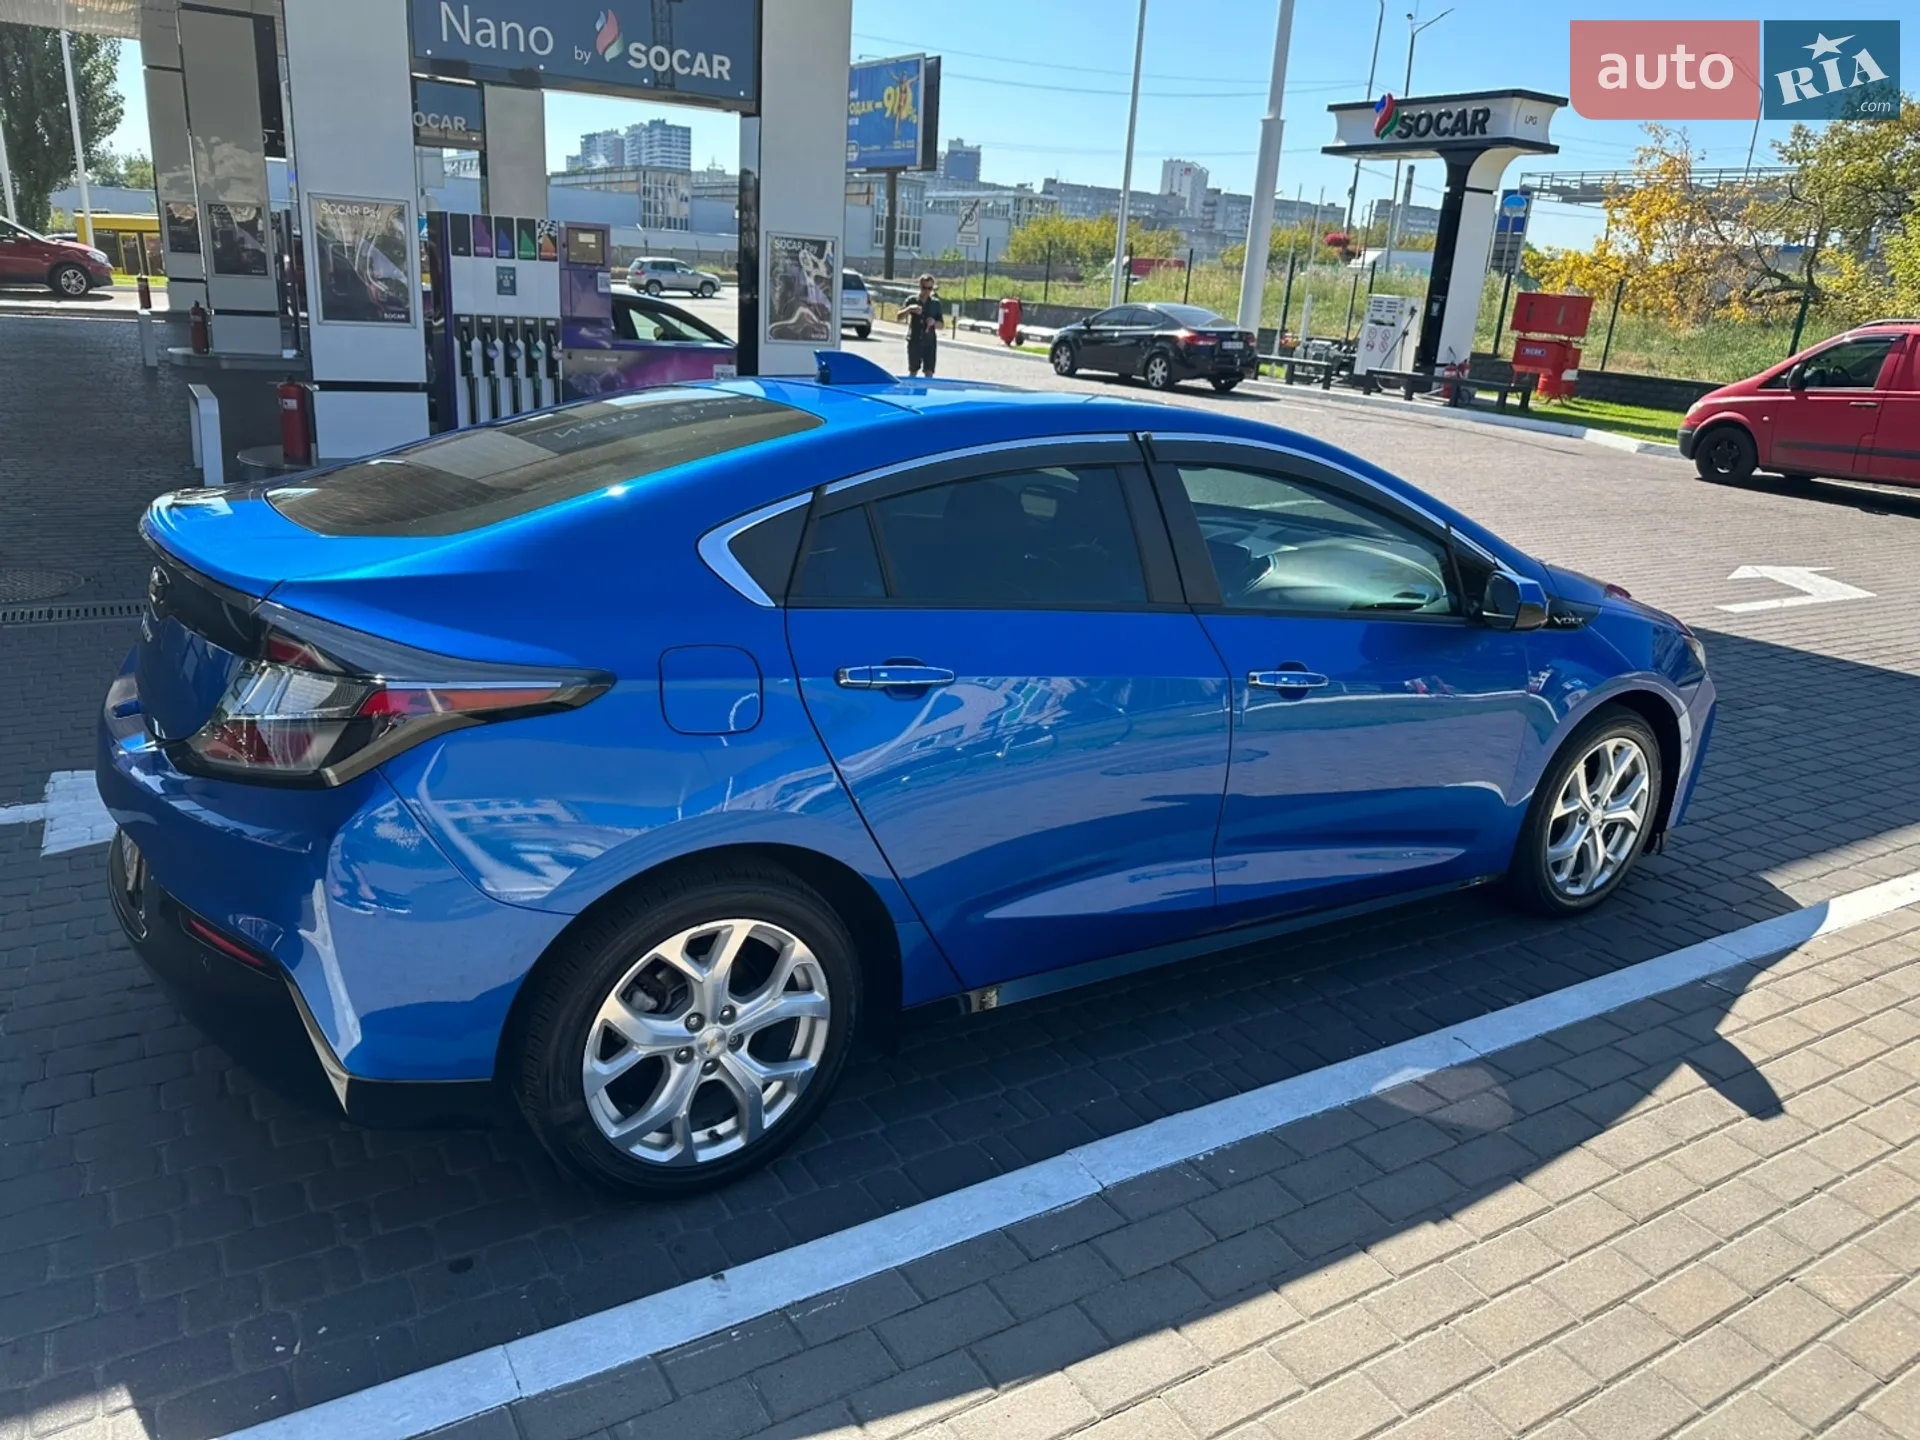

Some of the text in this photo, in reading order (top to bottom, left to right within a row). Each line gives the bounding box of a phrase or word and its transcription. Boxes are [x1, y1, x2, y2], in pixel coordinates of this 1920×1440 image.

[439, 1, 732, 81] Nano by SOCAR
[413, 111, 467, 131] OCAR
[1395, 106, 1491, 139] SOCAR
[320, 202, 381, 220] SOCAR Pay
[774, 239, 802, 250] SOCAR
